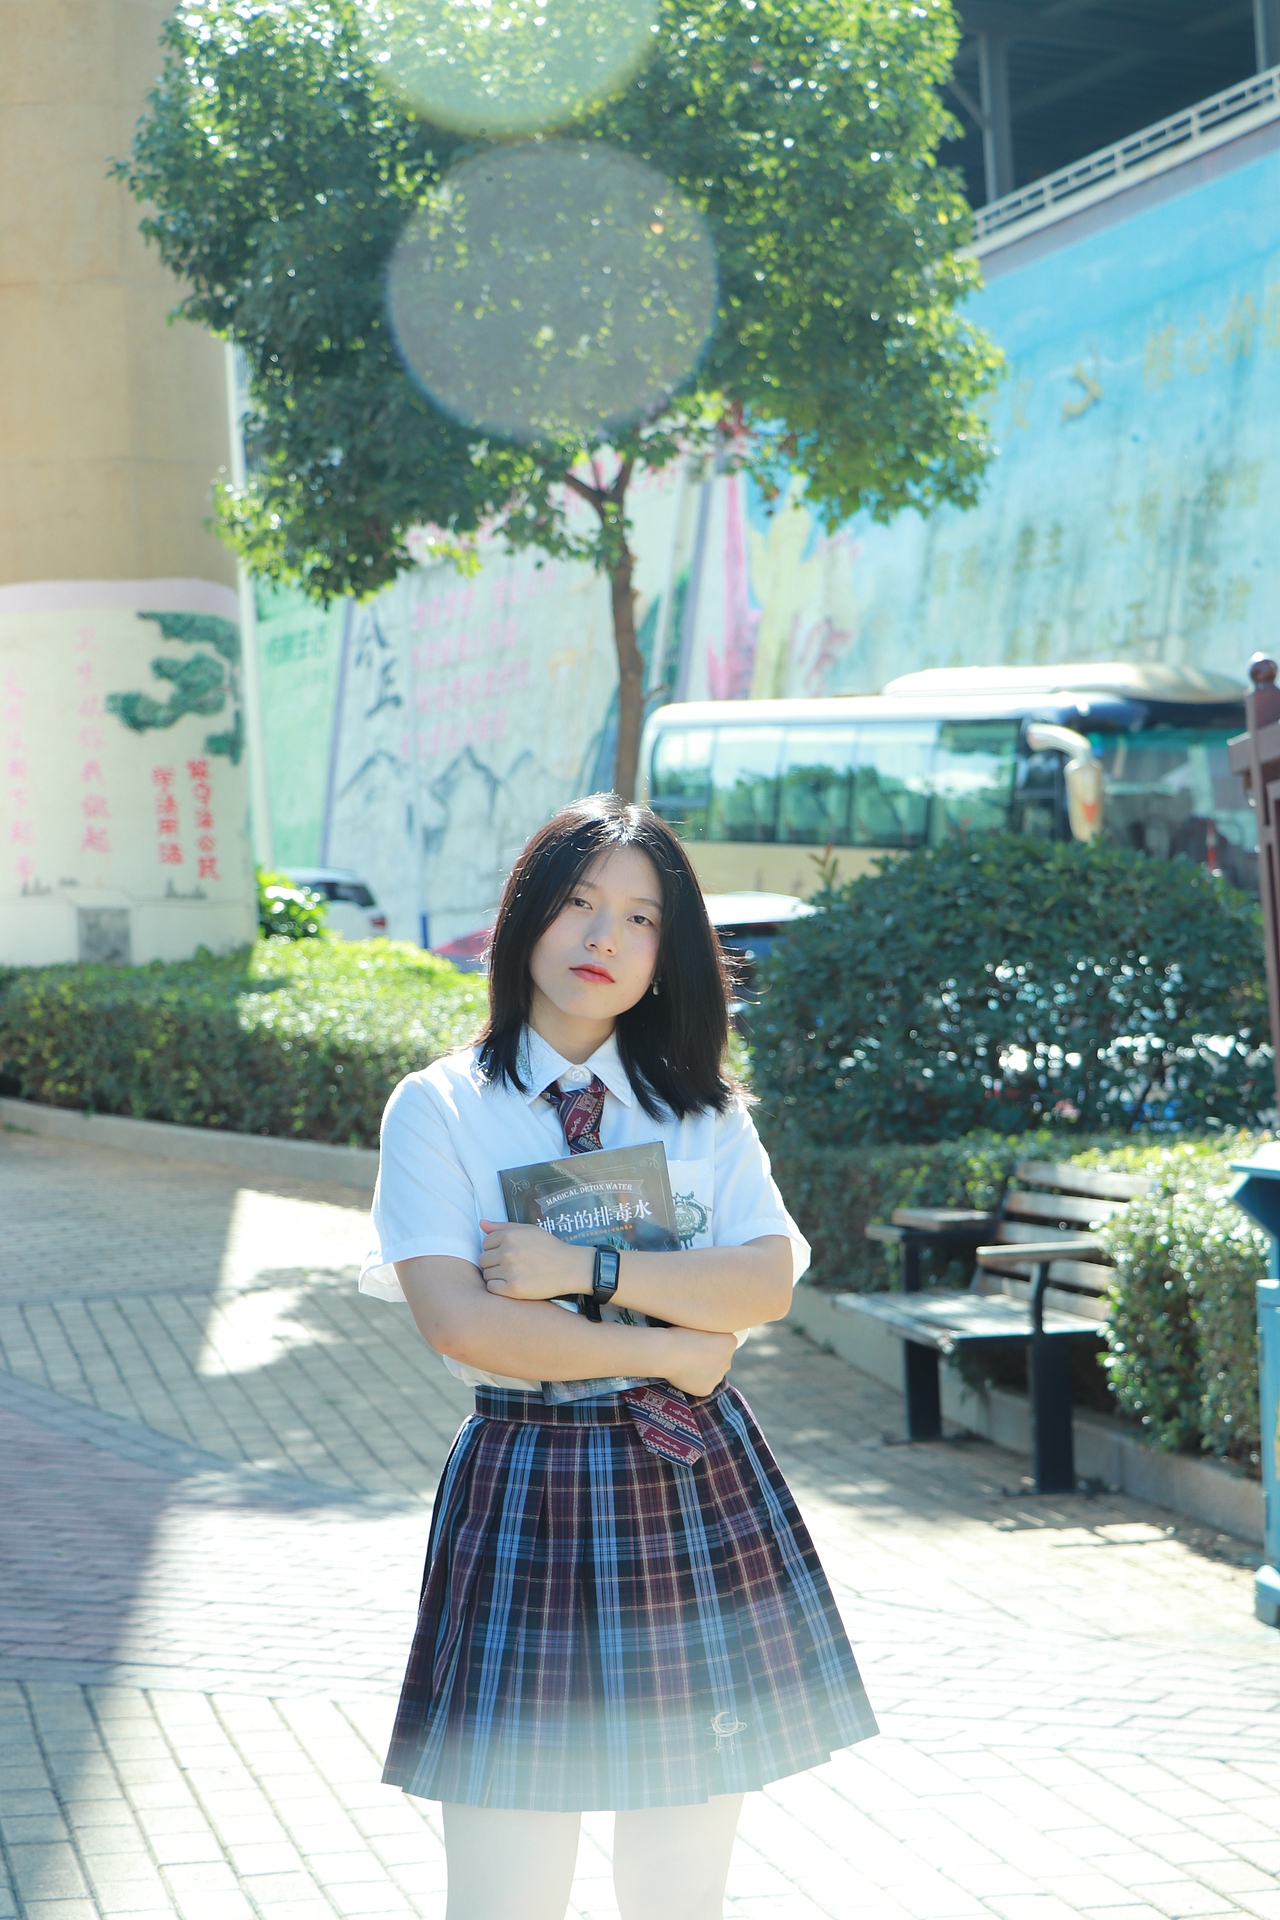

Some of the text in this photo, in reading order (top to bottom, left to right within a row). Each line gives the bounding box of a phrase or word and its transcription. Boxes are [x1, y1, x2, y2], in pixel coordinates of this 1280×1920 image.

[545, 1182, 633, 1206] MAGICAL DETOX WATER
[536, 1199, 653, 1234] 神奇的排毒水
